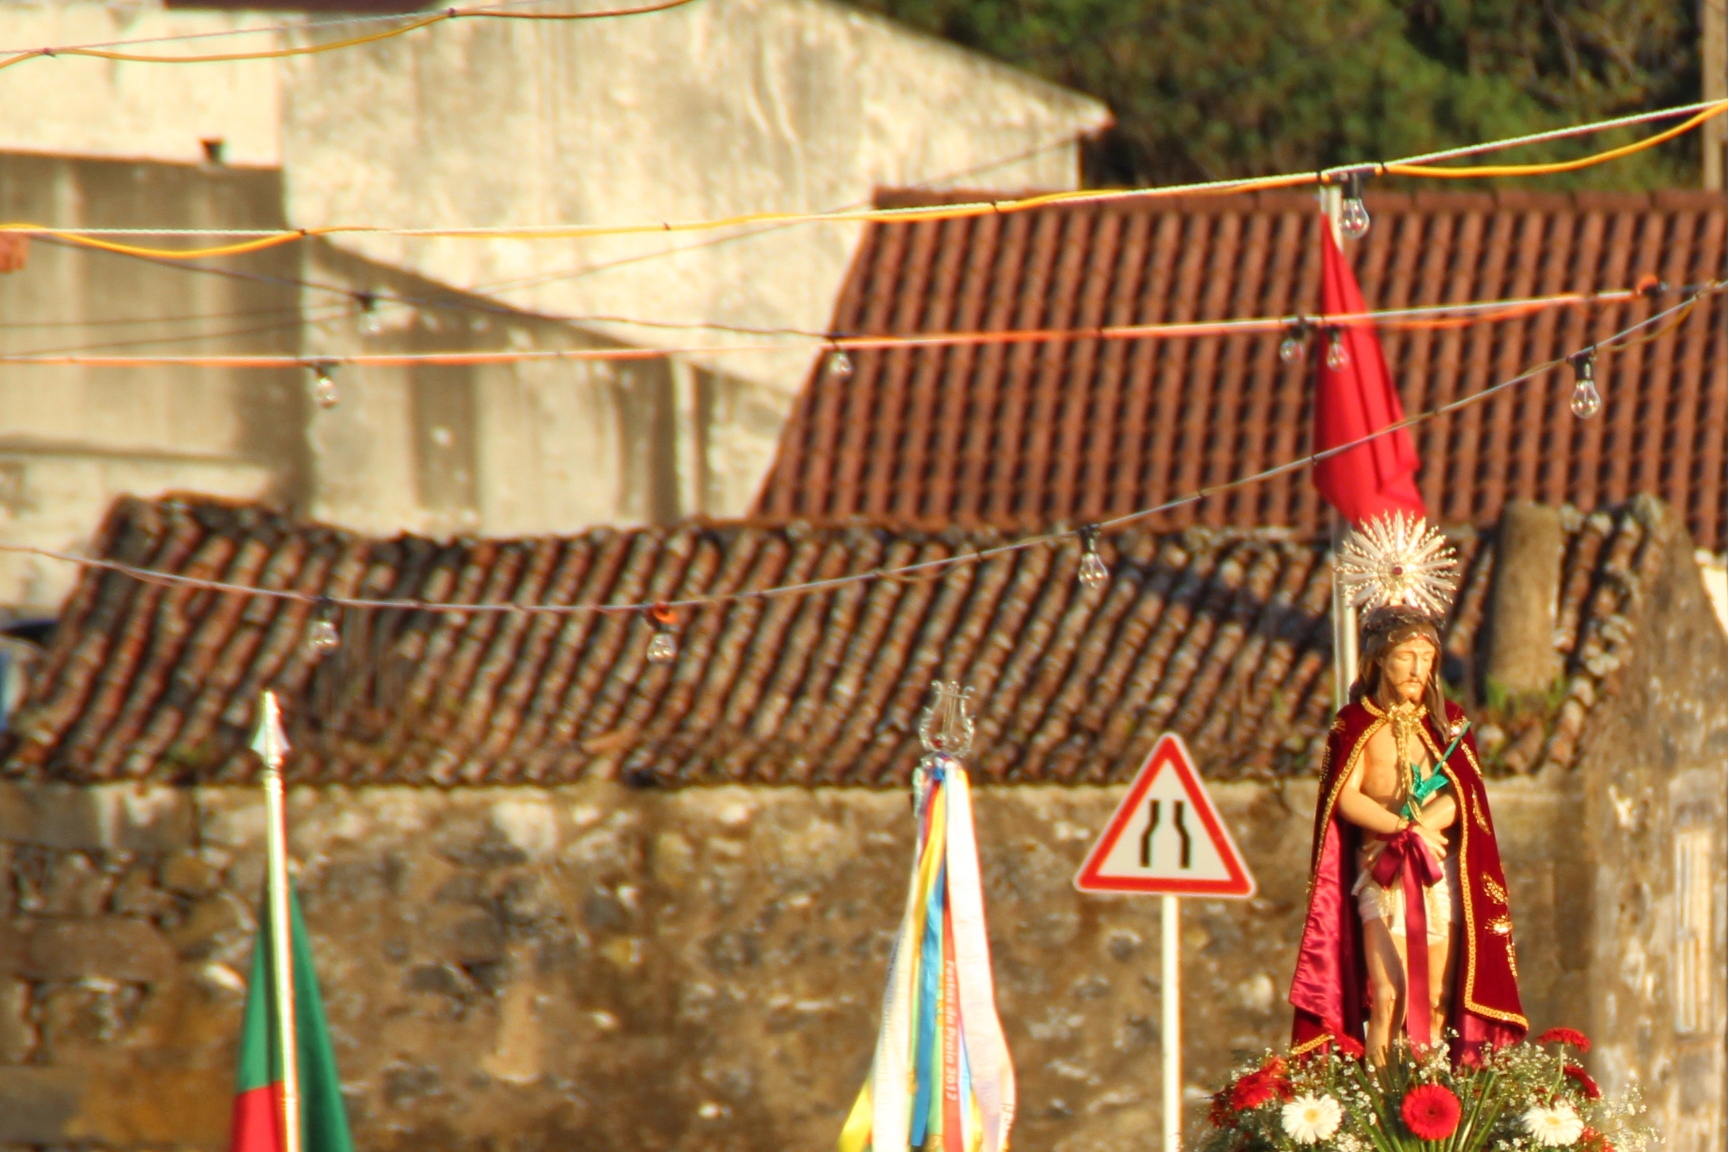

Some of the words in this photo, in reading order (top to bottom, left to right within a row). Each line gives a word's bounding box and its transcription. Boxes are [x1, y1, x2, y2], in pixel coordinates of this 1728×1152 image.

[945, 960, 956, 1003] Festas
[945, 1005, 957, 1024] da
[945, 1027, 956, 1064] Praia
[945, 1066, 957, 1101] 2012
